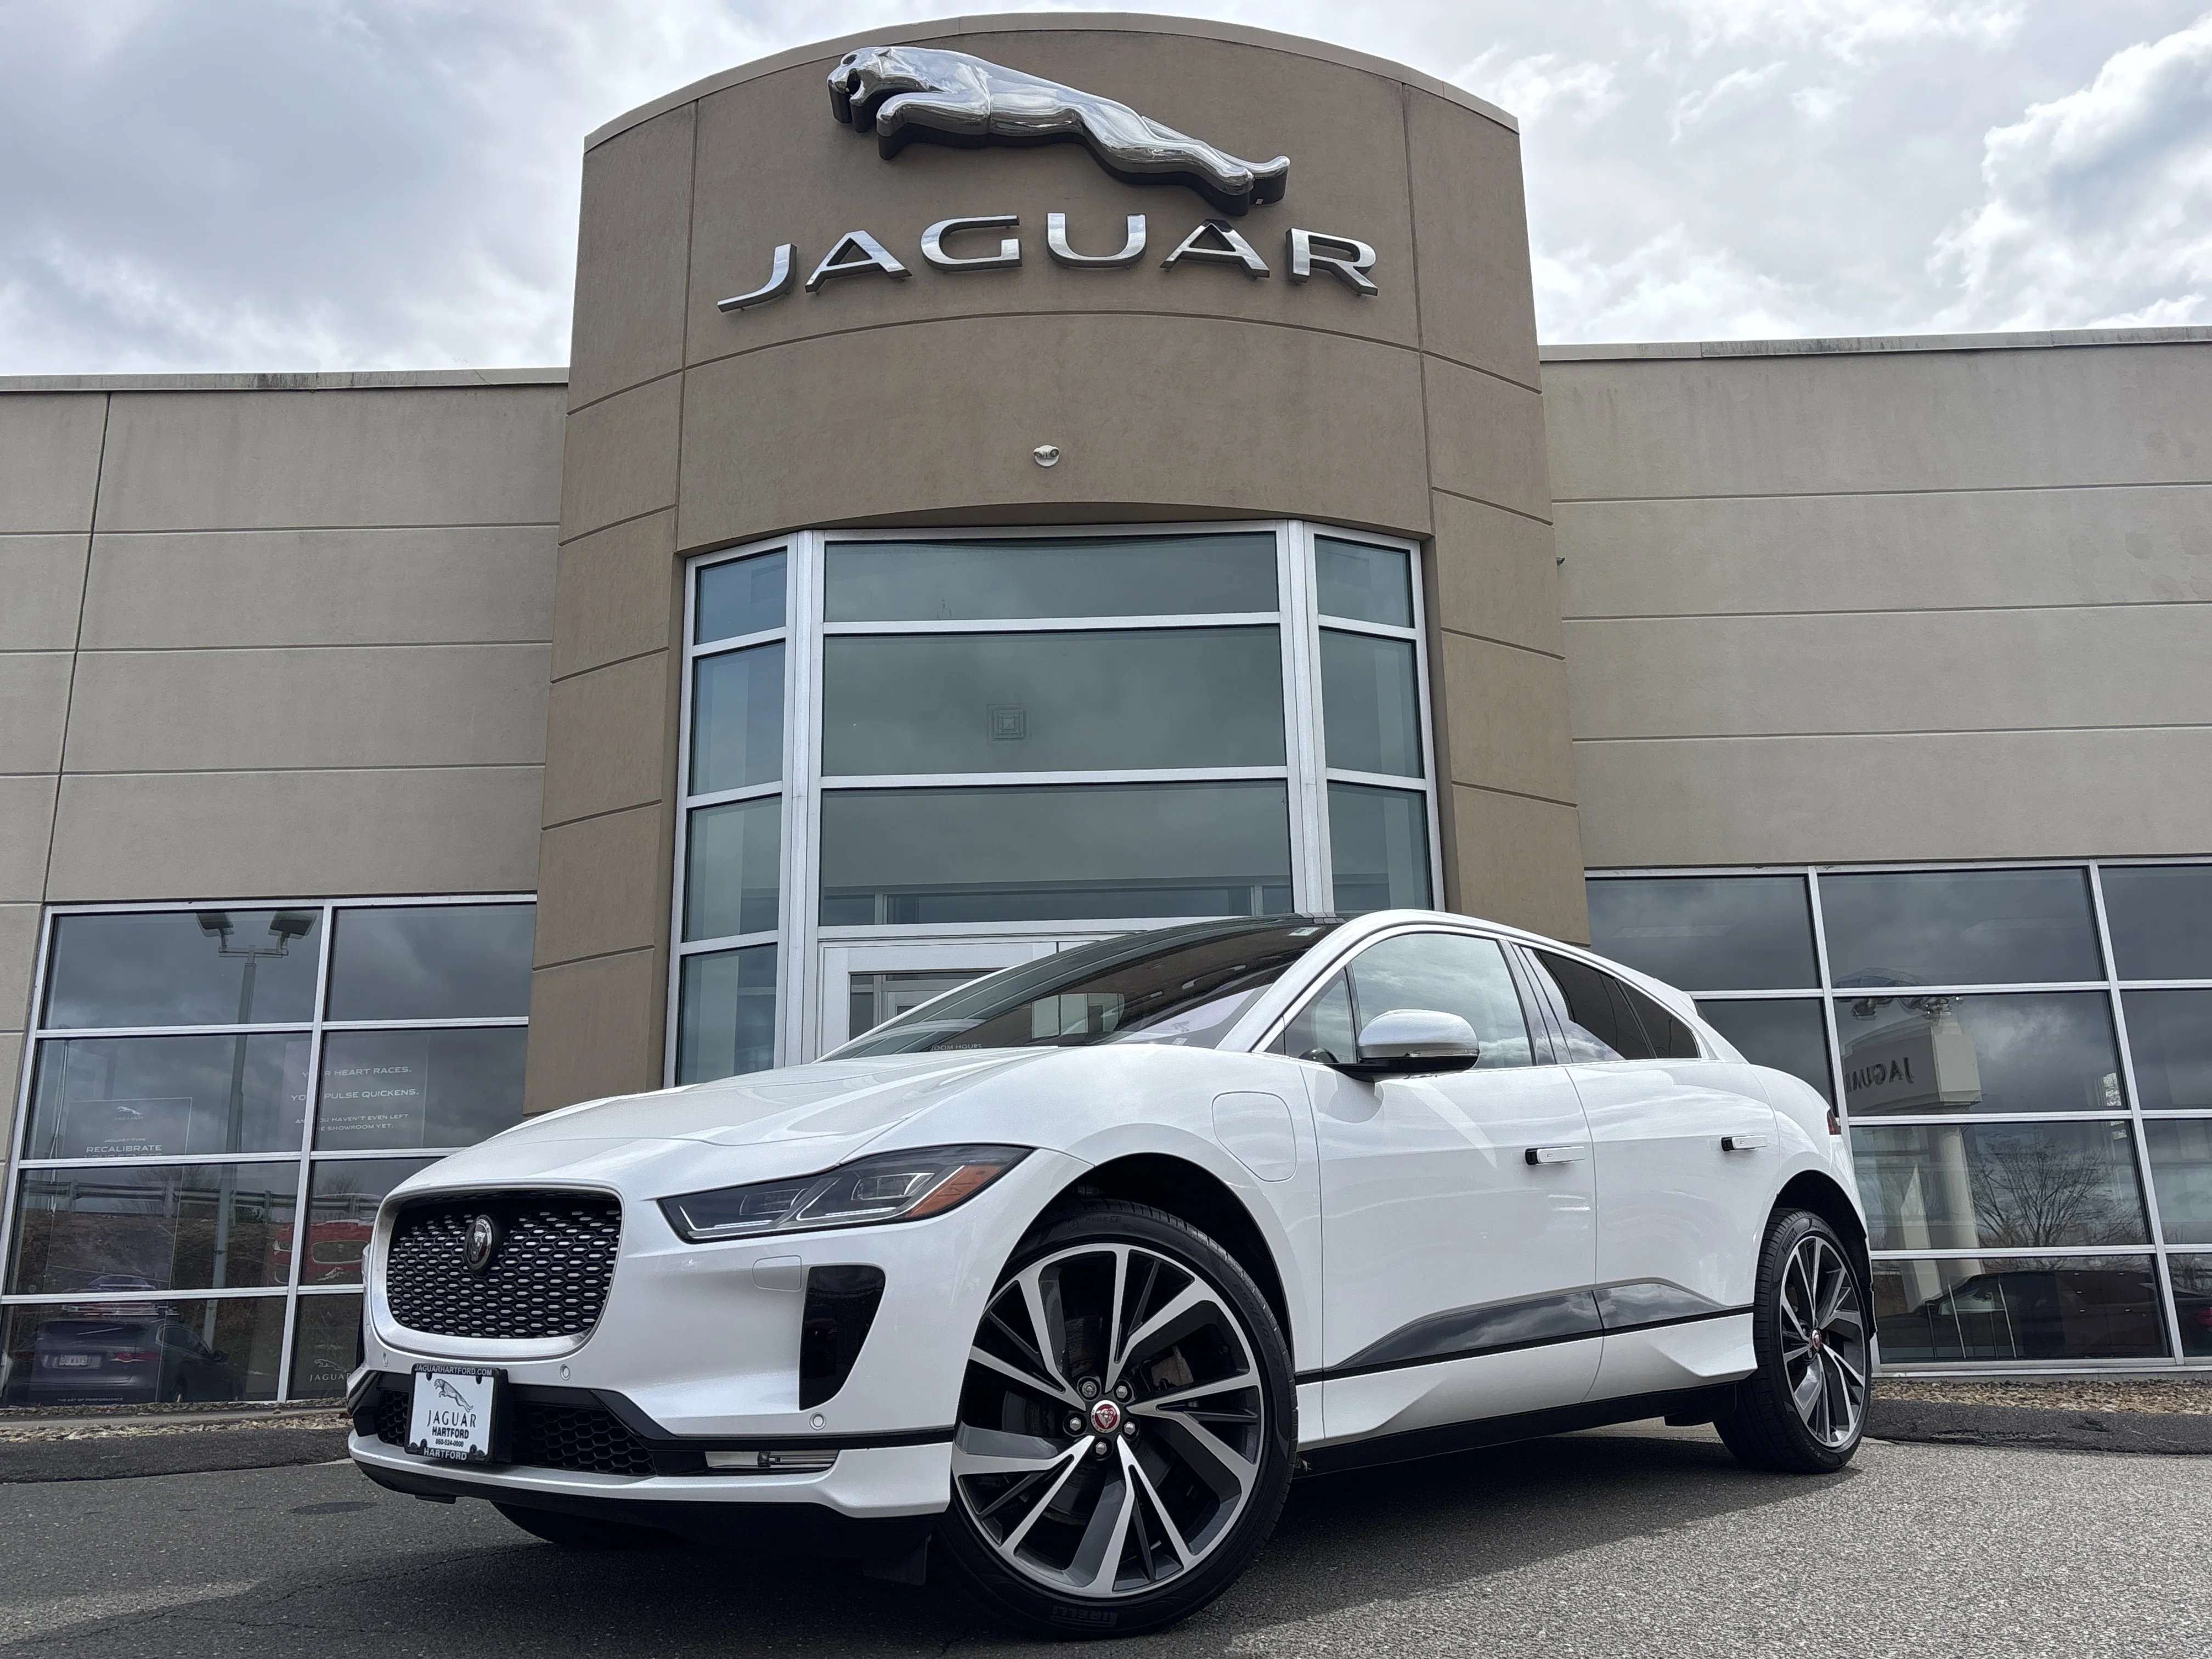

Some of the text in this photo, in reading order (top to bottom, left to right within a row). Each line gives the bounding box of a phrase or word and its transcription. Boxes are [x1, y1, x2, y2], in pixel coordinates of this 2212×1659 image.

[718, 212, 1379, 313] JAGUAR
[373, 1066, 411, 1075] RACES.
[362, 1088, 419, 1098] QUICKENS.
[86, 1144, 162, 1153] RECALIBRATE
[414, 1364, 493, 1376] JAGUARHARTFORD.COM
[427, 1409, 476, 1428] JAGUAR
[432, 1426, 469, 1439] HARTFORD
[424, 1447, 468, 1461] HARTFORD
